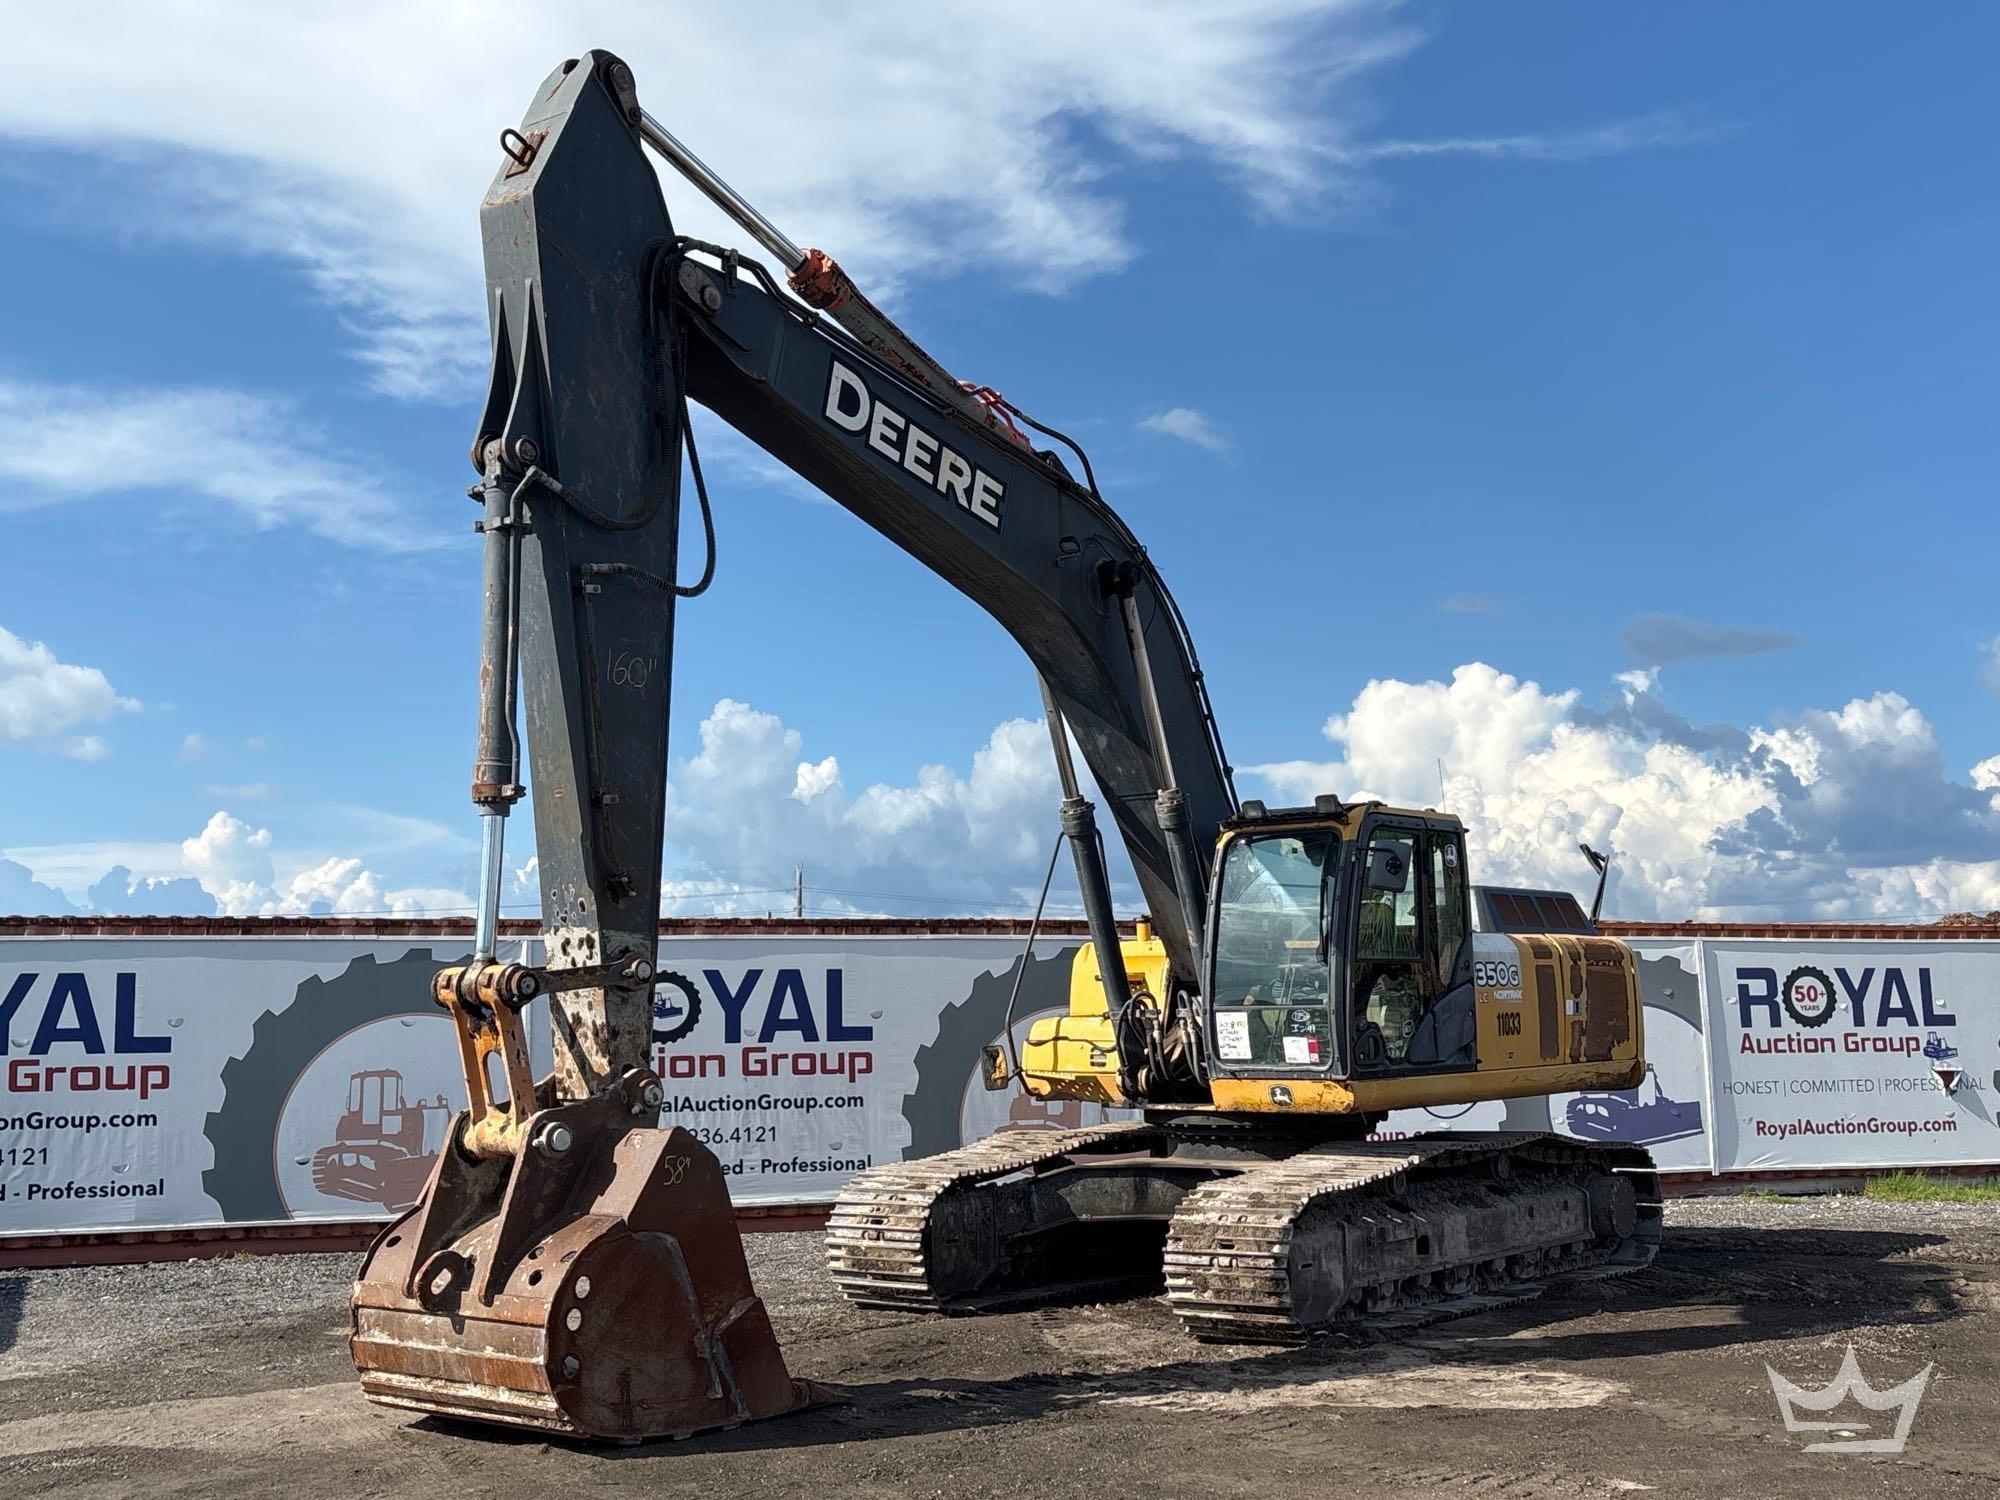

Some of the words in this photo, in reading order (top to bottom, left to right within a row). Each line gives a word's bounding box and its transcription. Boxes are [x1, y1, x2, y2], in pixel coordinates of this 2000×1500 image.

[825, 360, 1004, 528] DEERE
[606, 648, 657, 688] 160"
[1475, 961, 1520, 987] 350G
[1736, 965, 1957, 1028] ROYAL
[1794, 984, 1826, 1003] 50+
[1496, 1012, 1521, 1036] 11033
[1740, 1032, 1836, 1054] Auction
[1843, 1032, 1921, 1058] Group
[742, 1046, 873, 1083] Group
[8, 1059, 170, 1099] Group
[1722, 1080, 1780, 1095] HONEST
[1789, 1078, 1875, 1094] COMMITTED
[1885, 1077, 1987, 1093] PROFESSNAL
[1755, 1117, 1958, 1140] RoyalAuctionGroup.com
[761, 1154, 872, 1174] Professional
[27, 1178, 165, 1200] Professional
